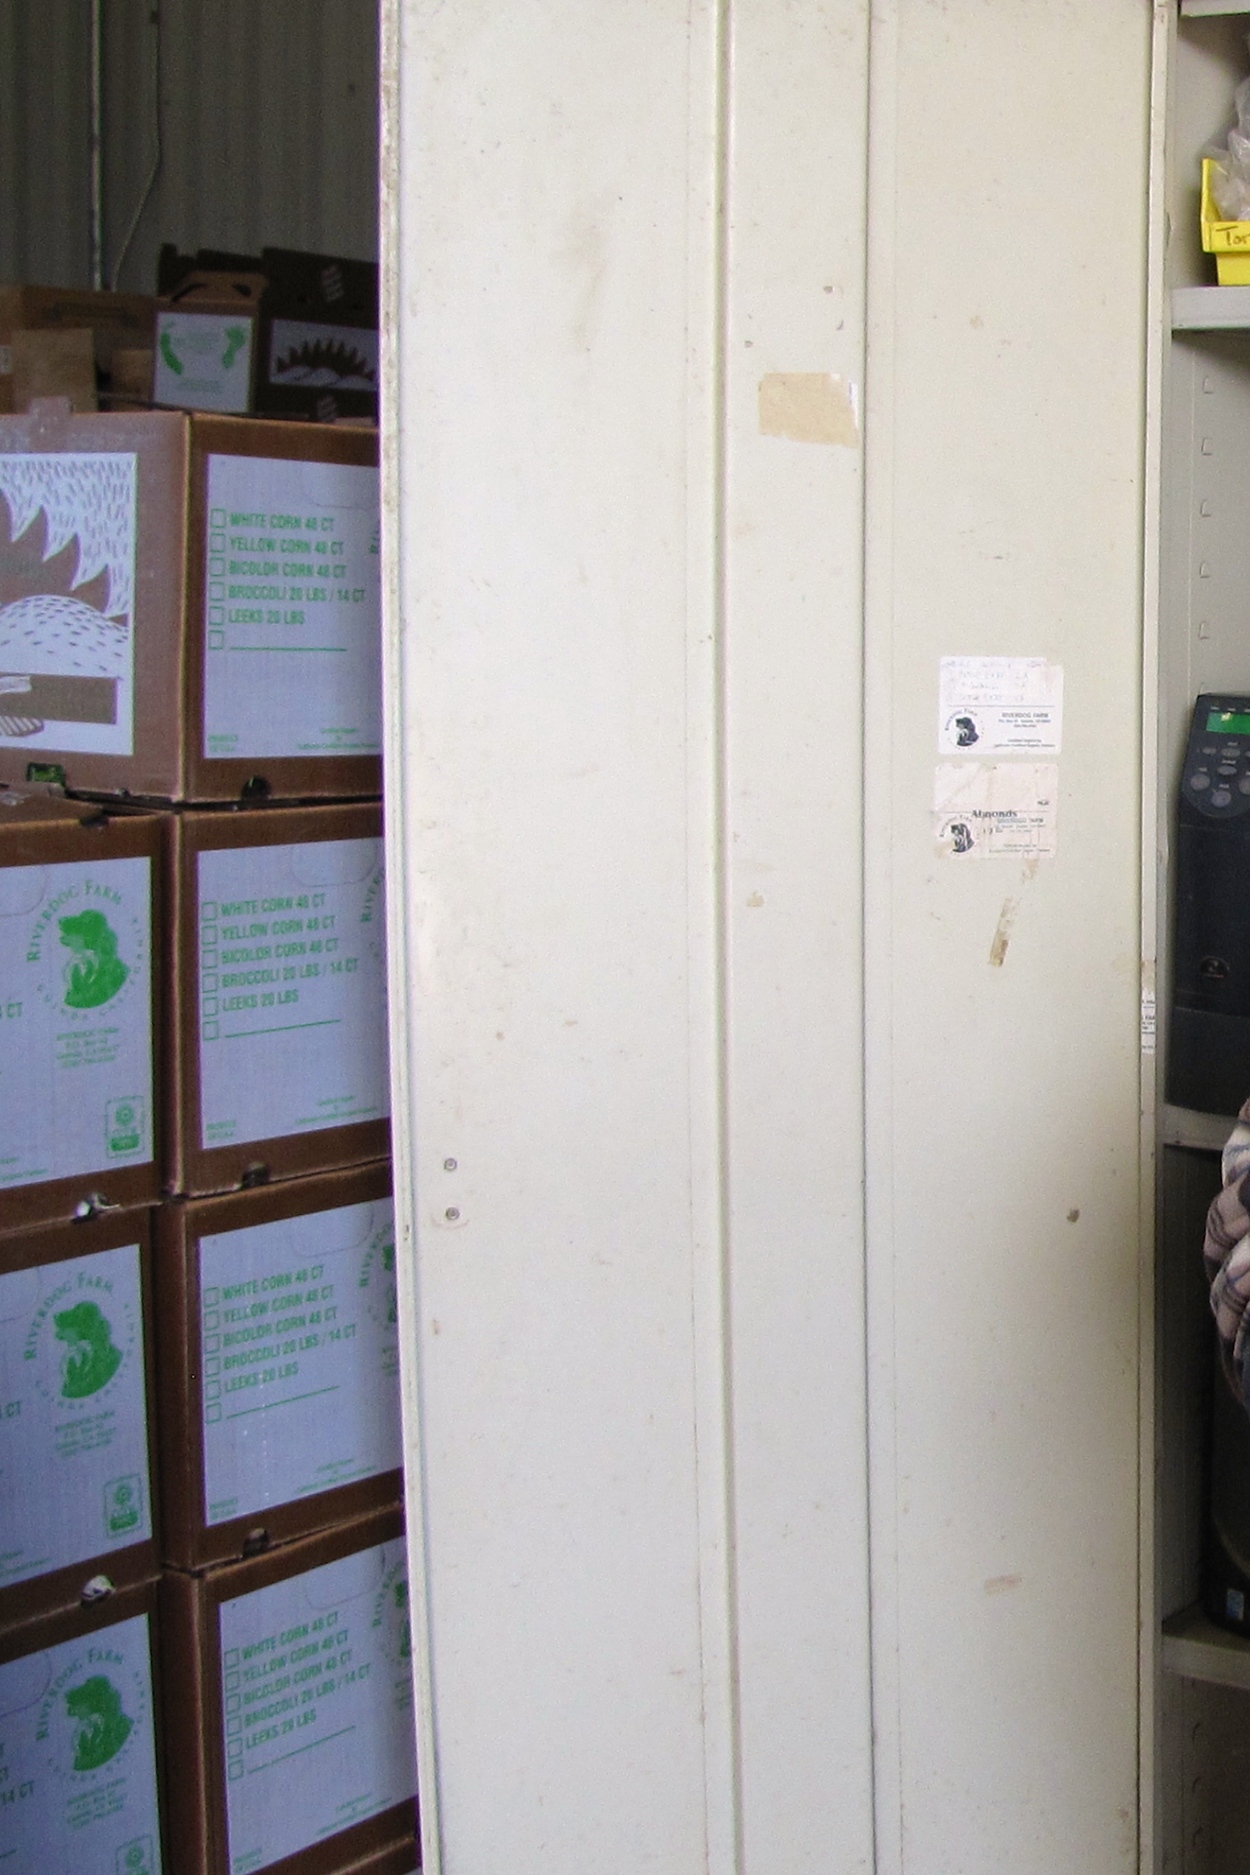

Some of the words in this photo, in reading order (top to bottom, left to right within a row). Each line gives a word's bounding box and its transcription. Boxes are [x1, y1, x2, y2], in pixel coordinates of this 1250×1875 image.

[230, 513, 266, 528] WHITE
[270, 514, 300, 529] CORN
[320, 517, 334, 531] CT
[230, 537, 276, 552] YELLOW
[281, 539, 310, 553] CORN
[330, 541, 344, 555] CT
[229, 560, 278, 576] BICOLOR
[283, 562, 313, 577] CORN
[333, 564, 347, 578] CT
[229, 585, 286, 600] BROCCOLI
[307, 587, 326, 601] LBS
[352, 588, 365, 602] CT
[229, 609, 263, 623] LEEKS
[284, 610, 304, 625] LBS
